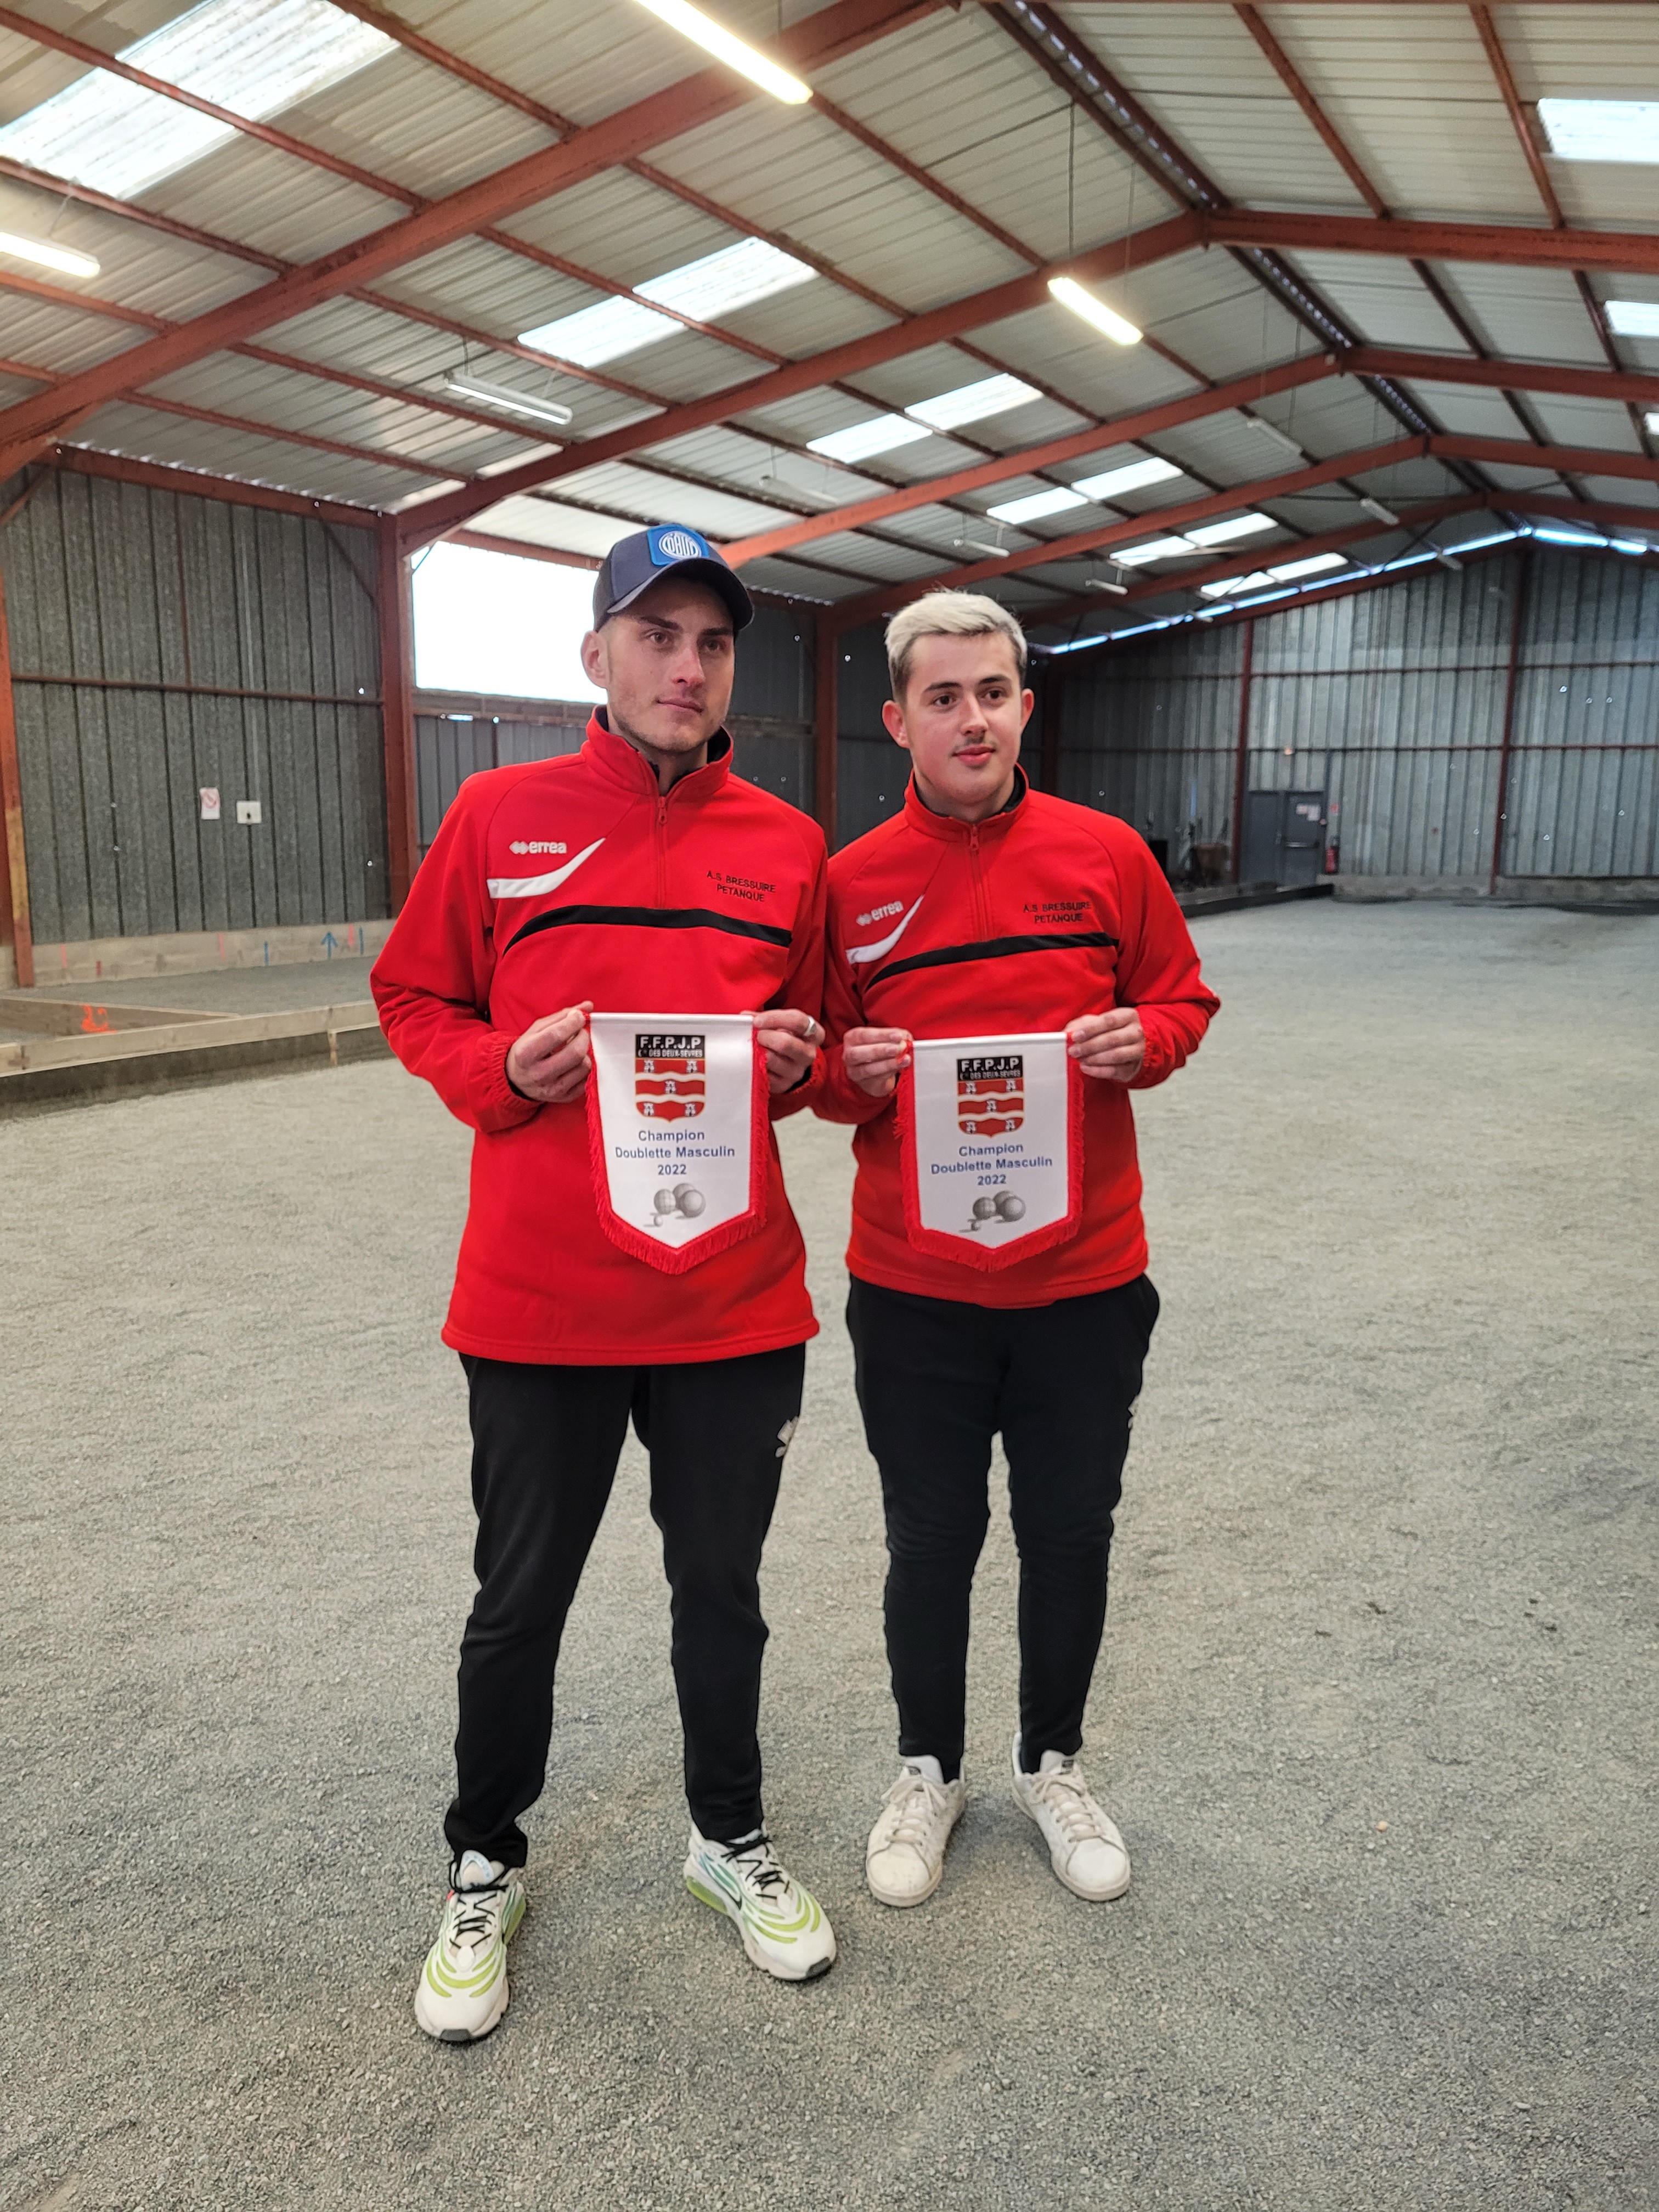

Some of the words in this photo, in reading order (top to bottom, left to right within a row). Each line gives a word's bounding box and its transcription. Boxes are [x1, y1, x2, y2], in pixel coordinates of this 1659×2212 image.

[529, 842, 567, 854] errea
[726, 876, 776, 893] BRESSUIRE
[717, 884, 765, 902] PETANQUE
[871, 901, 904, 921] errea
[1042, 902, 1091, 912] BRESSUIRE
[1035, 913, 1083, 924] PETANQUE
[640, 1036, 701, 1049] F.F.P.J.P
[961, 1057, 1019, 1072] F.F.P.J.P
[638, 1129, 705, 1143] Champion
[615, 1147, 672, 1158] Doublette
[676, 1146, 735, 1158] Masculin
[959, 1143, 1024, 1156] Champion
[658, 1164, 687, 1176] 2022
[931, 1161, 991, 1175] Doublette
[996, 1156, 1052, 1169] Masculin
[977, 1173, 1007, 1186] 2022
